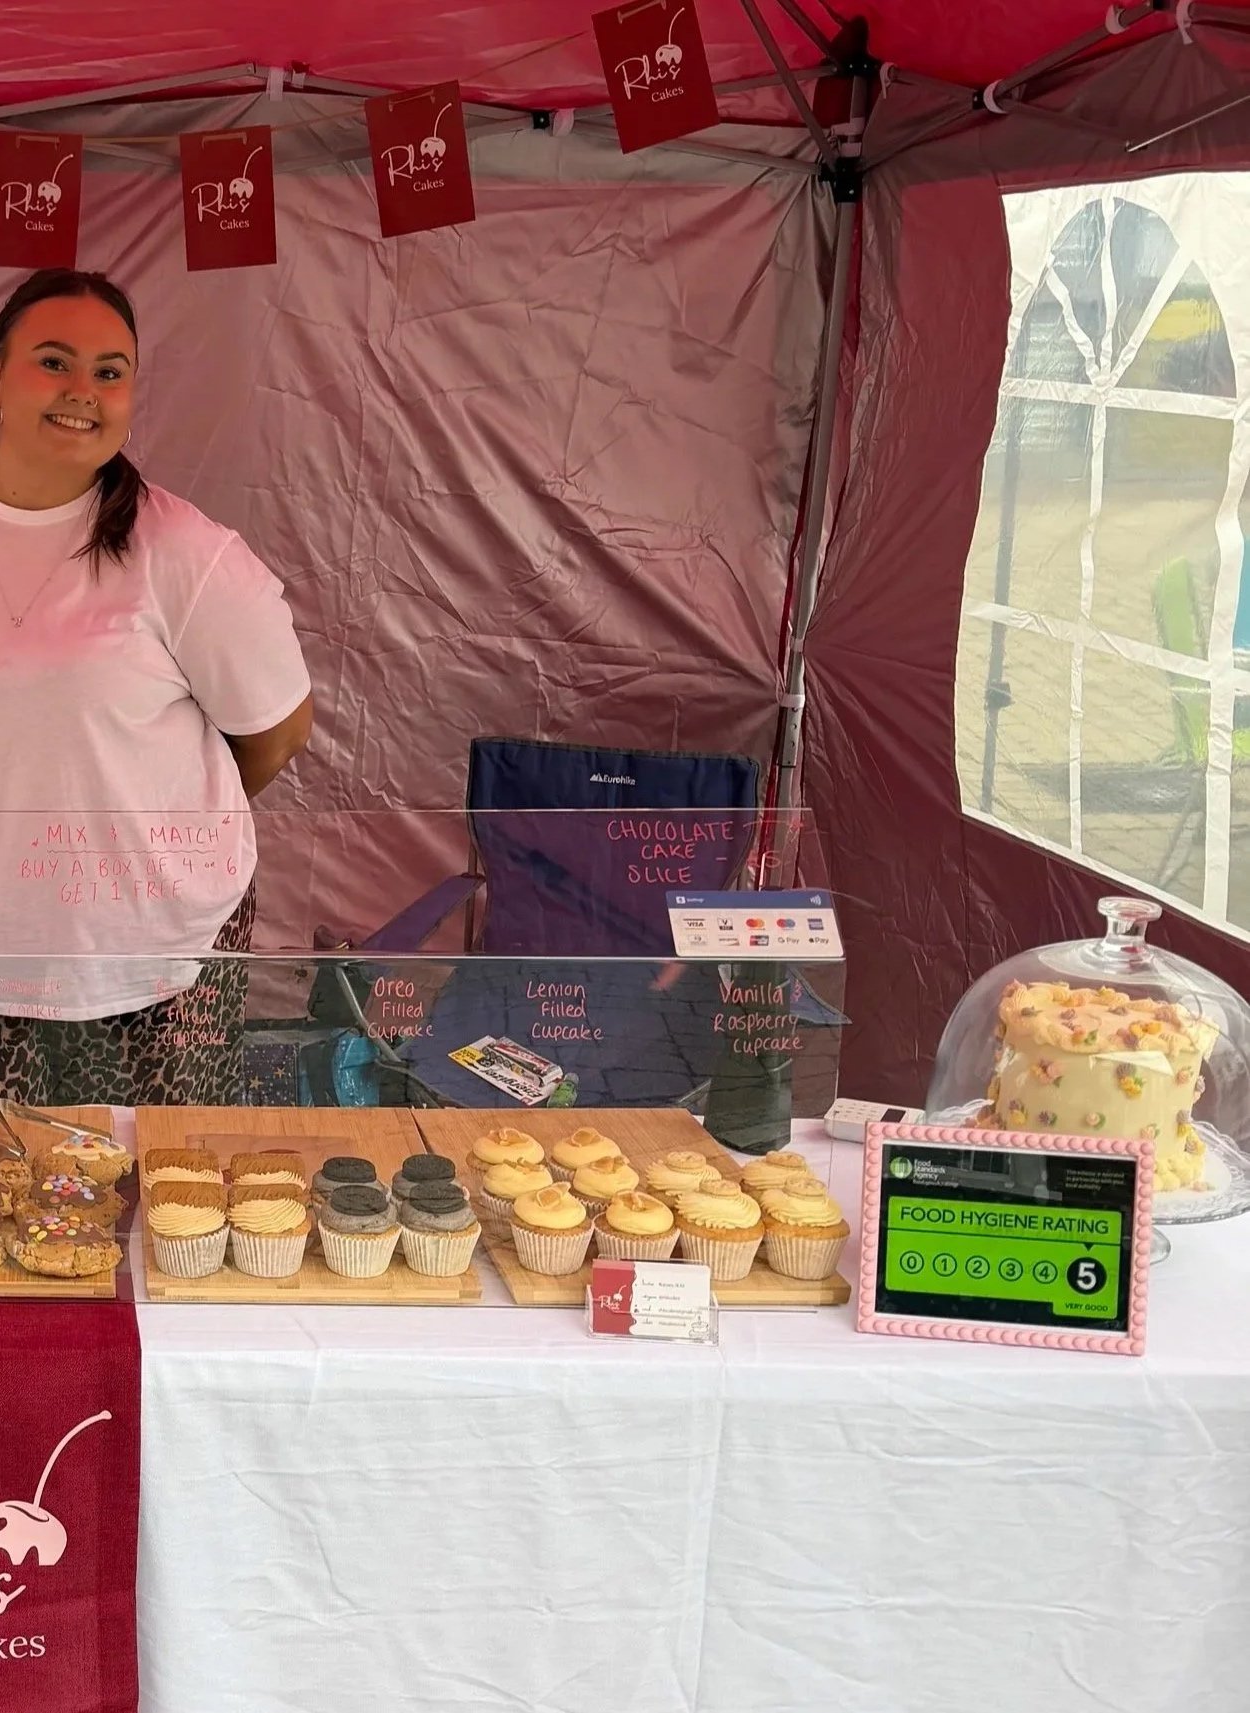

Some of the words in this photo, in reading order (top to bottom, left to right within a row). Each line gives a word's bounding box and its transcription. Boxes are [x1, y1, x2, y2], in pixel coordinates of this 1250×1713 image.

[651, 85, 685, 102] Cakes
[412, 177, 445, 192] Cakes
[25, 220, 55, 232] Cakes
[219, 217, 250, 230] Cakes
[603, 774, 636, 786] Eurohike
[47, 824, 87, 844] MIX
[150, 826, 219, 845] MATCH
[607, 819, 735, 843] CHOCOLATE
[641, 843, 696, 860] CAKE
[21, 859, 59, 879] BUY
[71, 860, 84, 877] A
[99, 858, 132, 878] BOX
[146, 857, 168, 876] OF
[182, 857, 193, 874] 4
[226, 856, 237, 876] 6
[628, 864, 692, 884] SLICE
[61, 882, 98, 904] GET
[110, 881, 122, 901] 1
[134, 880, 183, 899] FREE
[786, 937, 800, 945] Pay
[155, 977, 221, 1006] Bcoff
[374, 976, 414, 998] Oreo
[526, 979, 586, 999] Lemon
[719, 980, 784, 1005] Vanilla
[382, 1001, 424, 1018] Filled
[368, 1022, 434, 1042] Cupcake
[532, 1023, 605, 1041] Cupcake
[713, 1012, 800, 1036] Raspberry
[914, 1158, 932, 1168] Food
[901, 1206, 956, 1224] FOOD
[960, 1211, 1039, 1231] HYGIENE
[1042, 1217, 1110, 1235] RATING
[906, 1255, 918, 1269] 0
[1076, 1262, 1098, 1290] 5
[1065, 1302, 1084, 1310] VERY
[1084, 1303, 1109, 1312] GOOD
